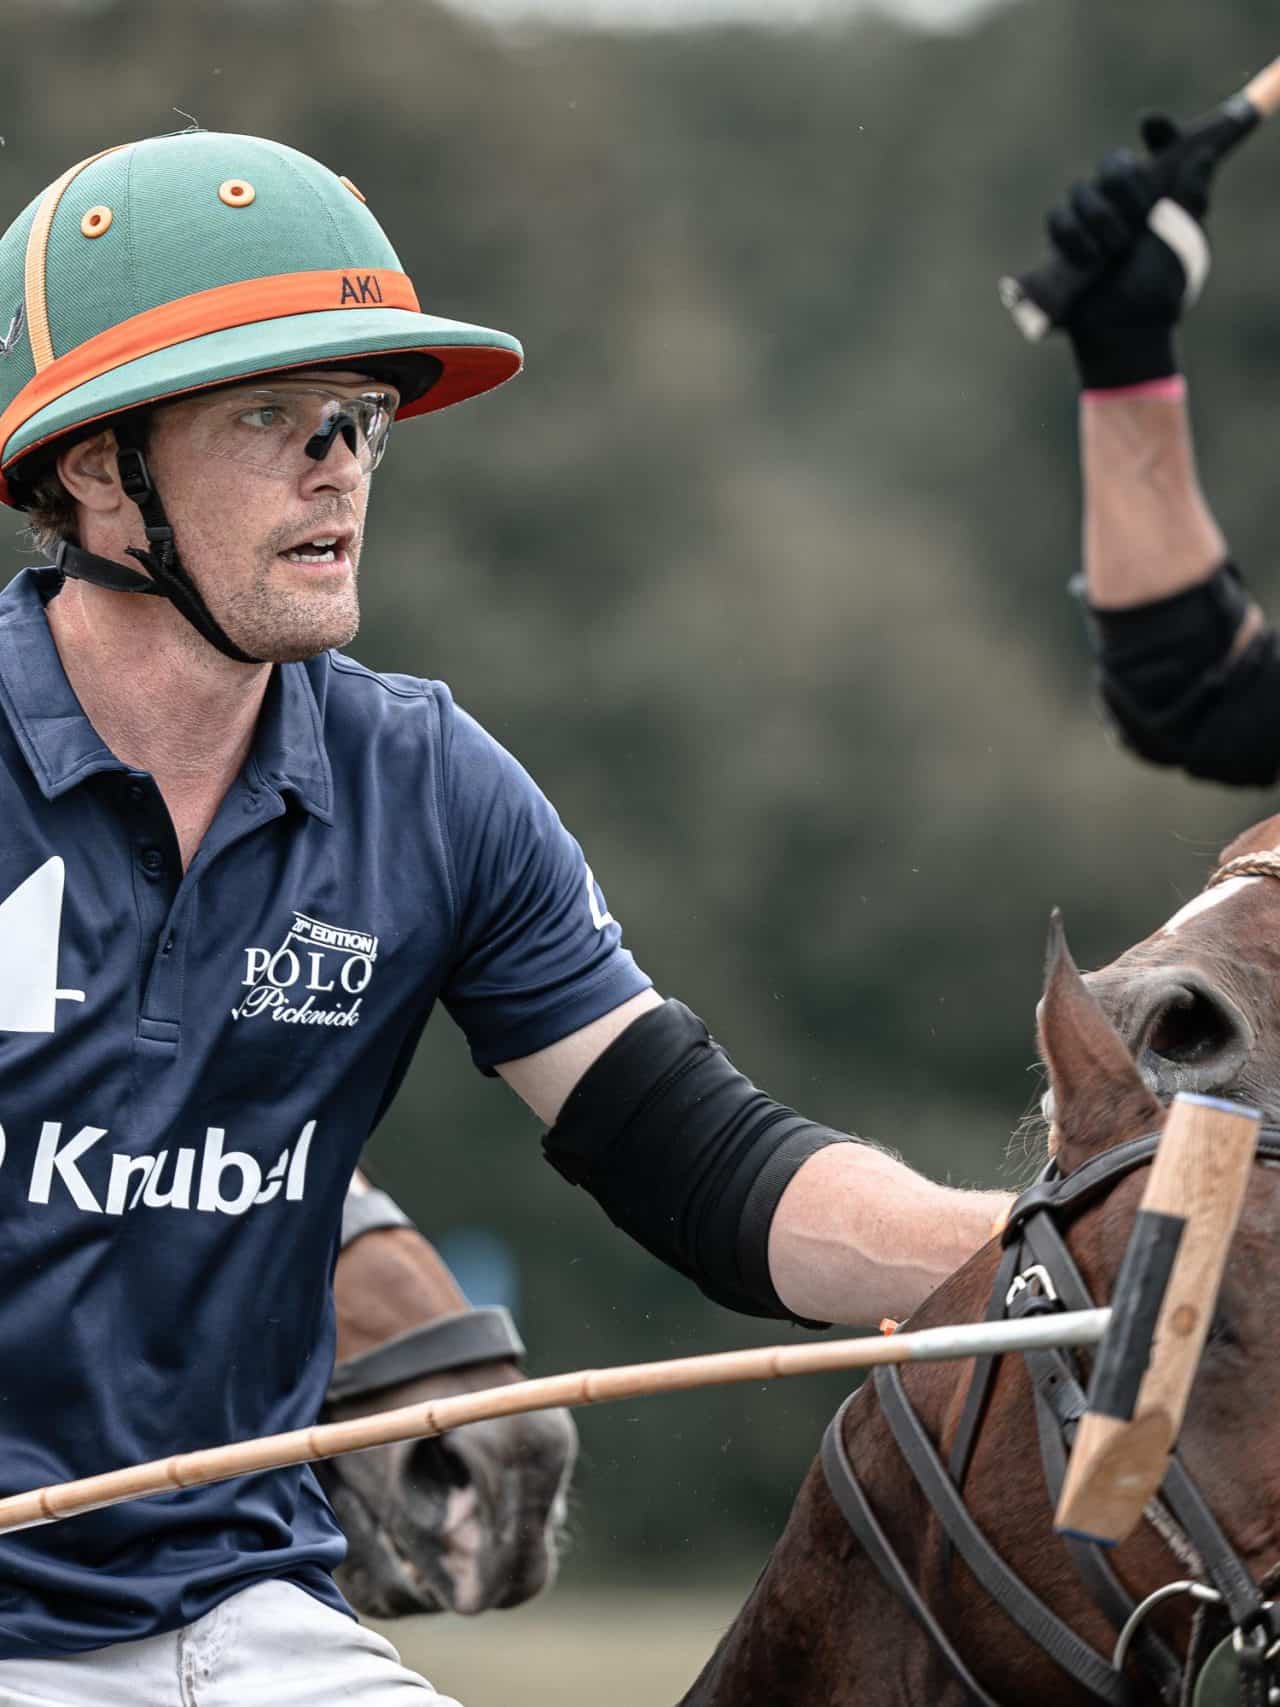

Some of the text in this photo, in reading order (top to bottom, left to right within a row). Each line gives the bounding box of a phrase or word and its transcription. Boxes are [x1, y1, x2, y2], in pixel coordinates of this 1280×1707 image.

[340, 275, 383, 305] AKI
[310, 924, 373, 953] EDITION
[241, 948, 373, 994] POLO
[241, 986, 363, 1026] Picknick
